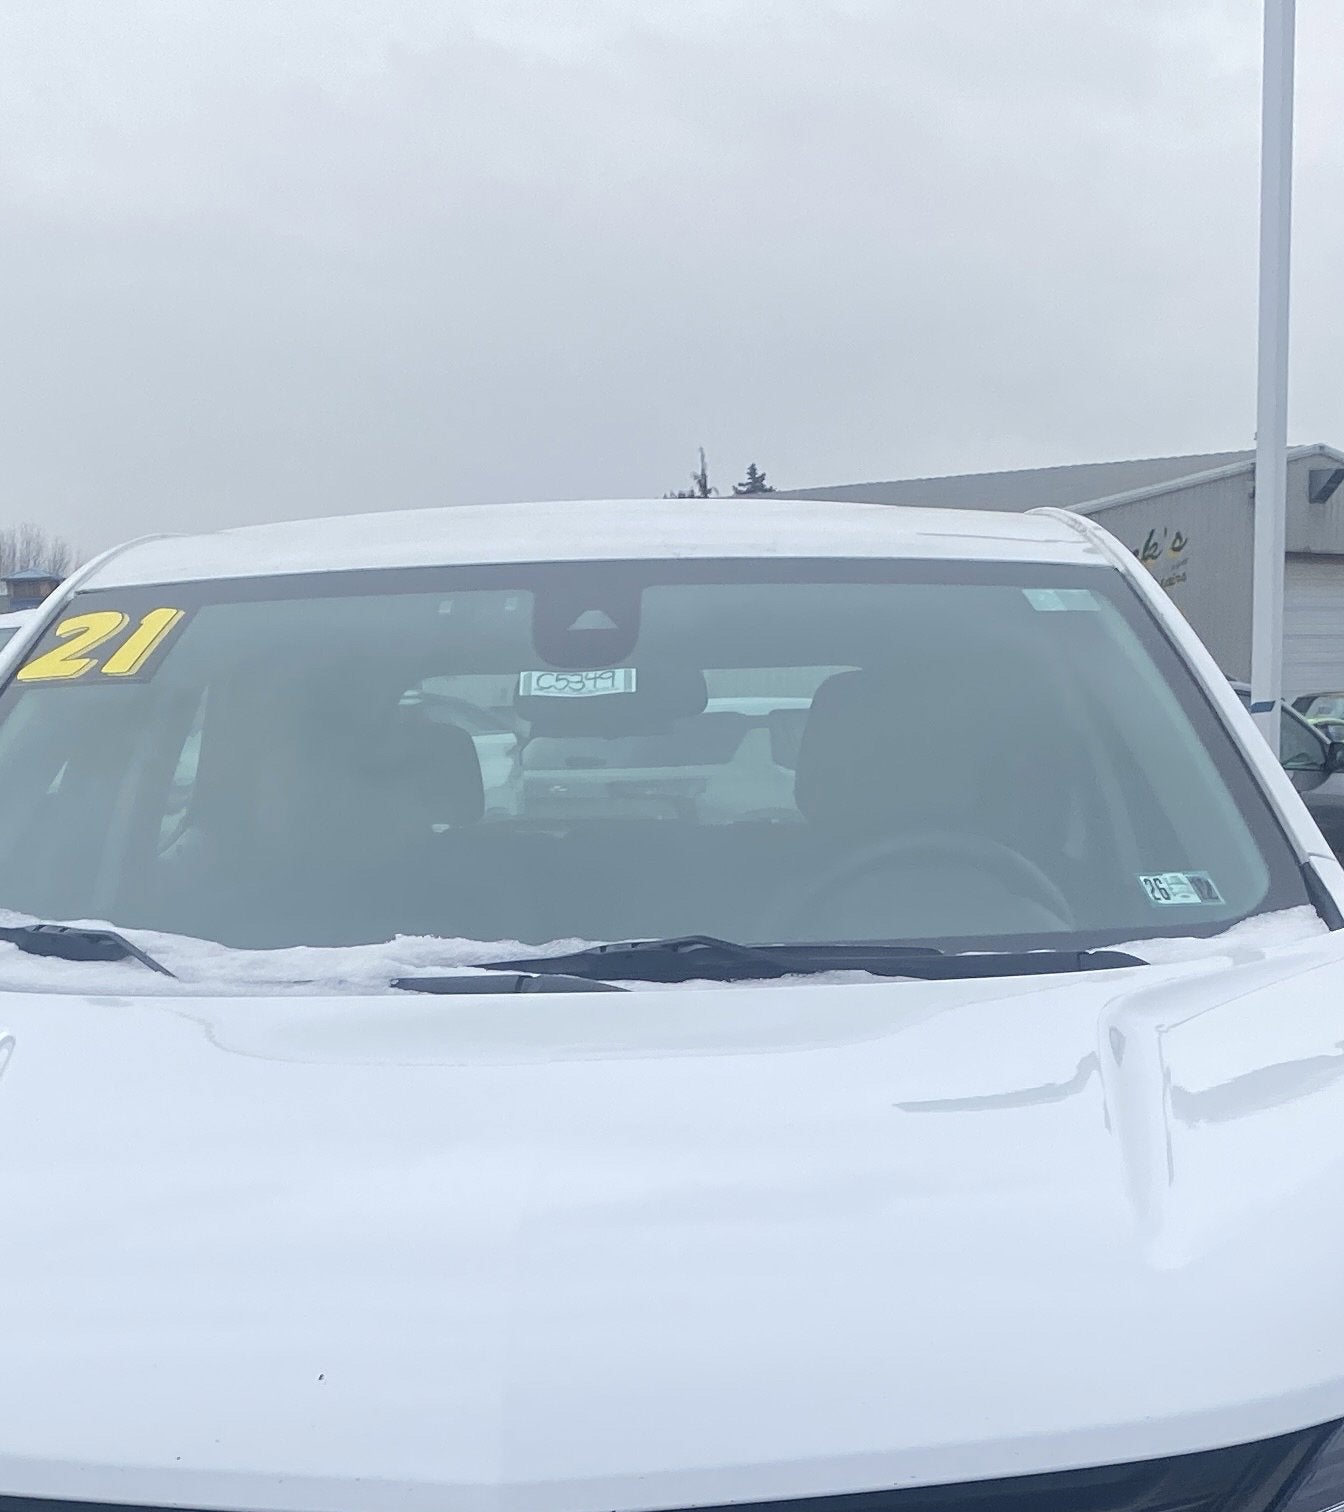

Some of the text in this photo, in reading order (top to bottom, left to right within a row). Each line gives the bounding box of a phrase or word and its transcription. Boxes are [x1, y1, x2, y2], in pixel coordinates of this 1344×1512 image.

[17, 607, 186, 682] 21
[537, 671, 616, 691] C5349
[1143, 878, 1172, 901] 26
